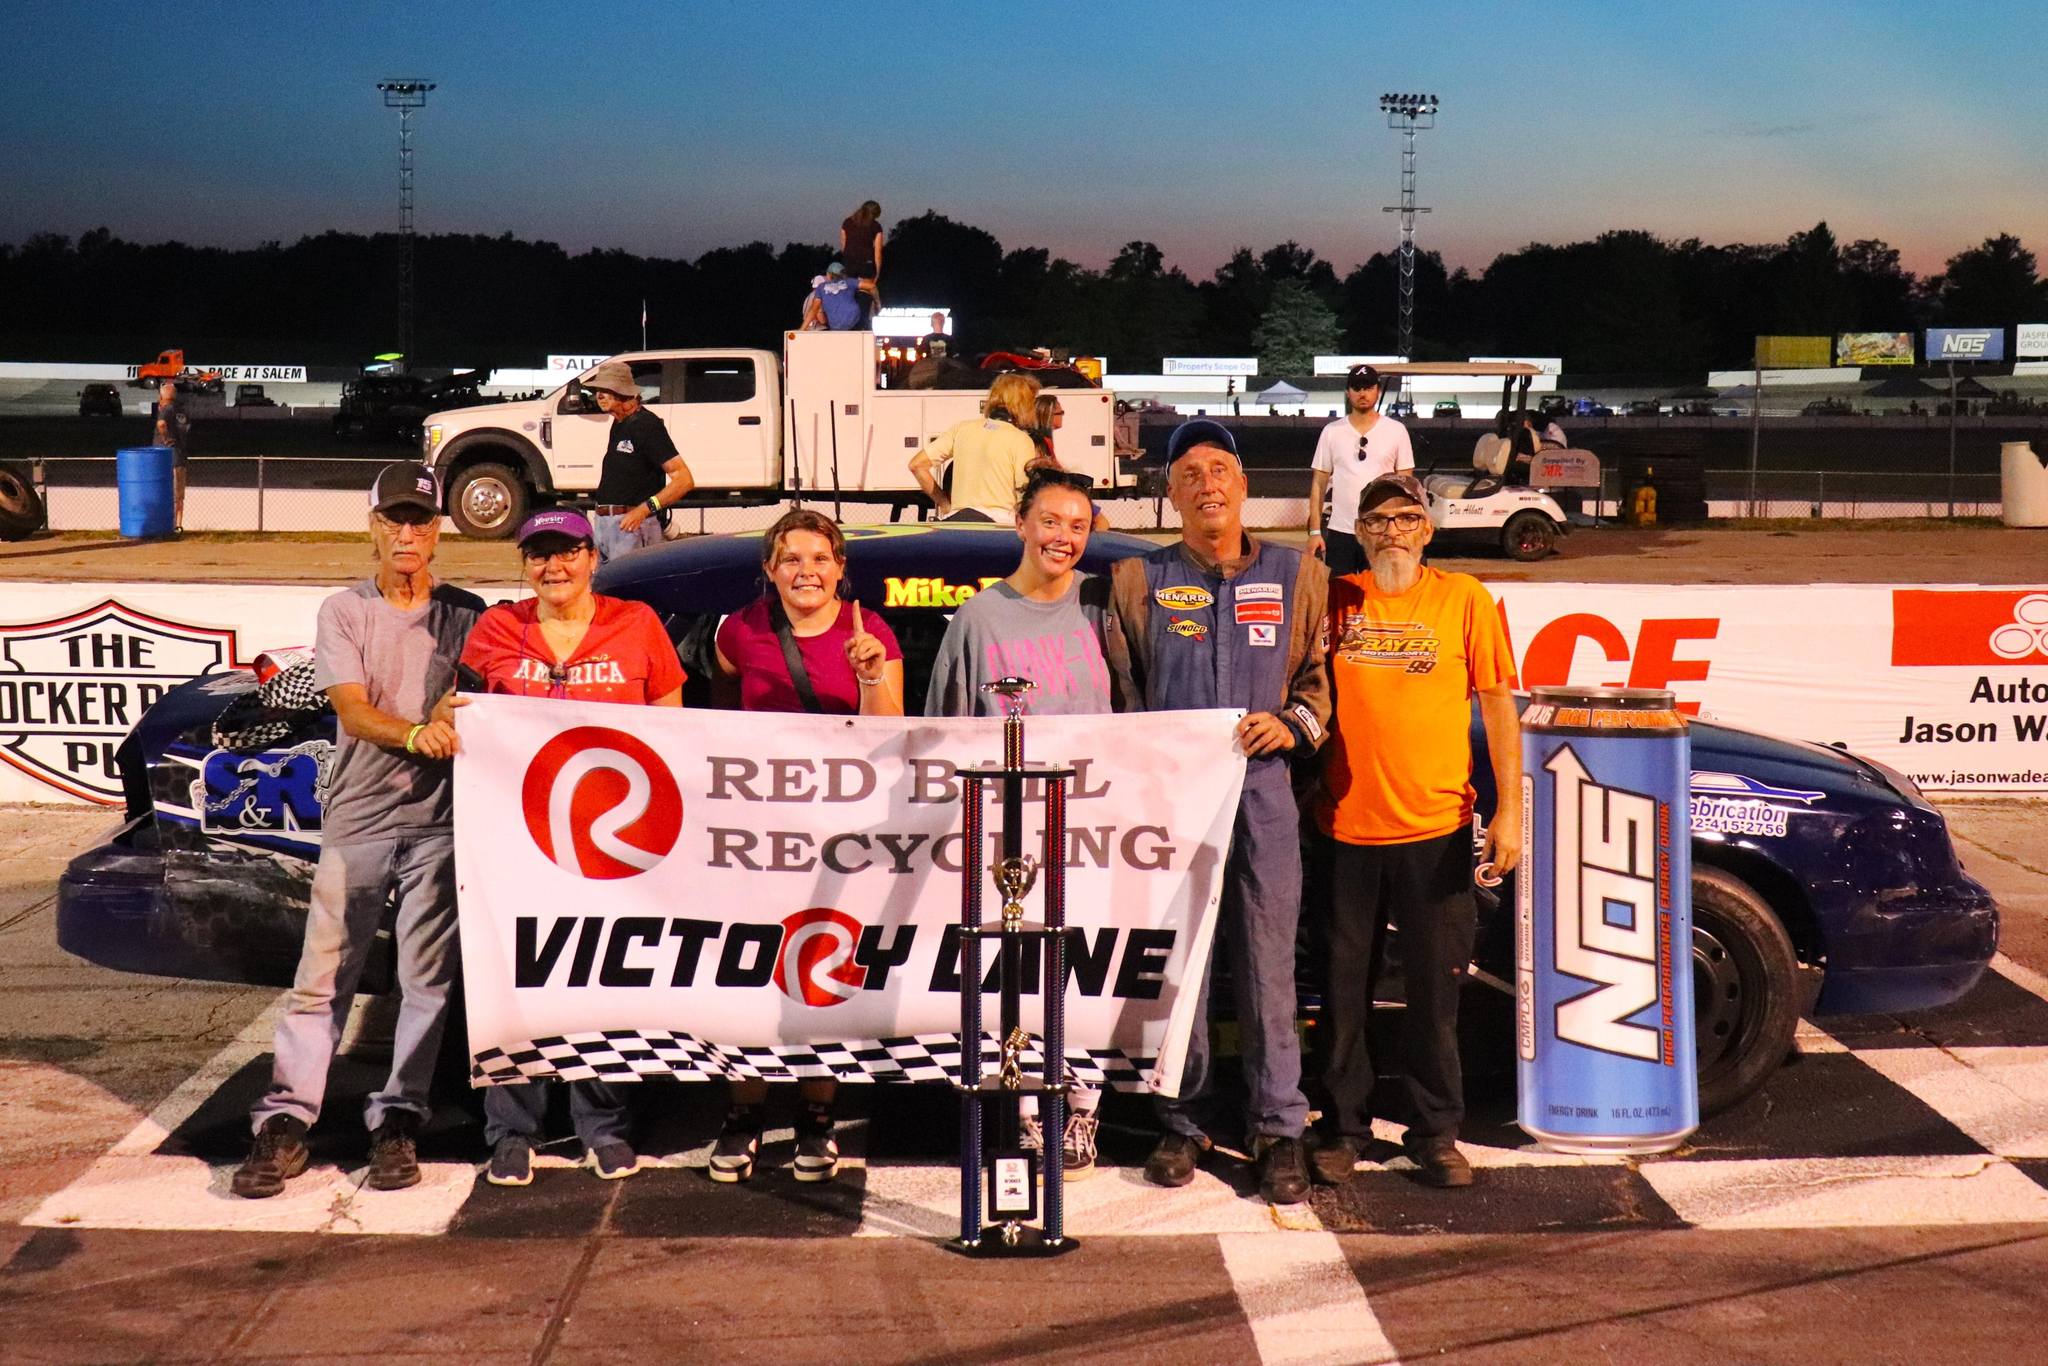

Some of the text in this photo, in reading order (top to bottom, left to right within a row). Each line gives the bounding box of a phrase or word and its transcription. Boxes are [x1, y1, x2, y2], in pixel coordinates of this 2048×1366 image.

[1942, 333, 1991, 353] NOS
[244, 368, 259, 379] AT
[262, 367, 302, 379] SALEM
[1178, 362, 1256, 371] Property Scope Ops
[884, 577, 975, 607] Mike
[1154, 589, 1215, 604] MENARDS
[1167, 624, 1208, 633] SUNOCO
[60, 633, 155, 668] THE
[1360, 650, 1431, 658] MOTORSPORTS
[1363, 638, 1440, 652] BAYER
[513, 658, 626, 685] AMRICA
[1969, 676, 2048, 703] Auto
[1899, 715, 2048, 743] Jason W
[706, 755, 877, 803] RED
[1542, 741, 1661, 1064] NOS
[1658, 802, 1675, 1068] HIGH PERFORMANCE ENERGY DRINK
[515, 908, 918, 1006] VICTORY
[1520, 979, 1531, 1049] CMPLX6
[1548, 1104, 1599, 1118] ENERGY DRINK
[1611, 1108, 1621, 1119] 16
